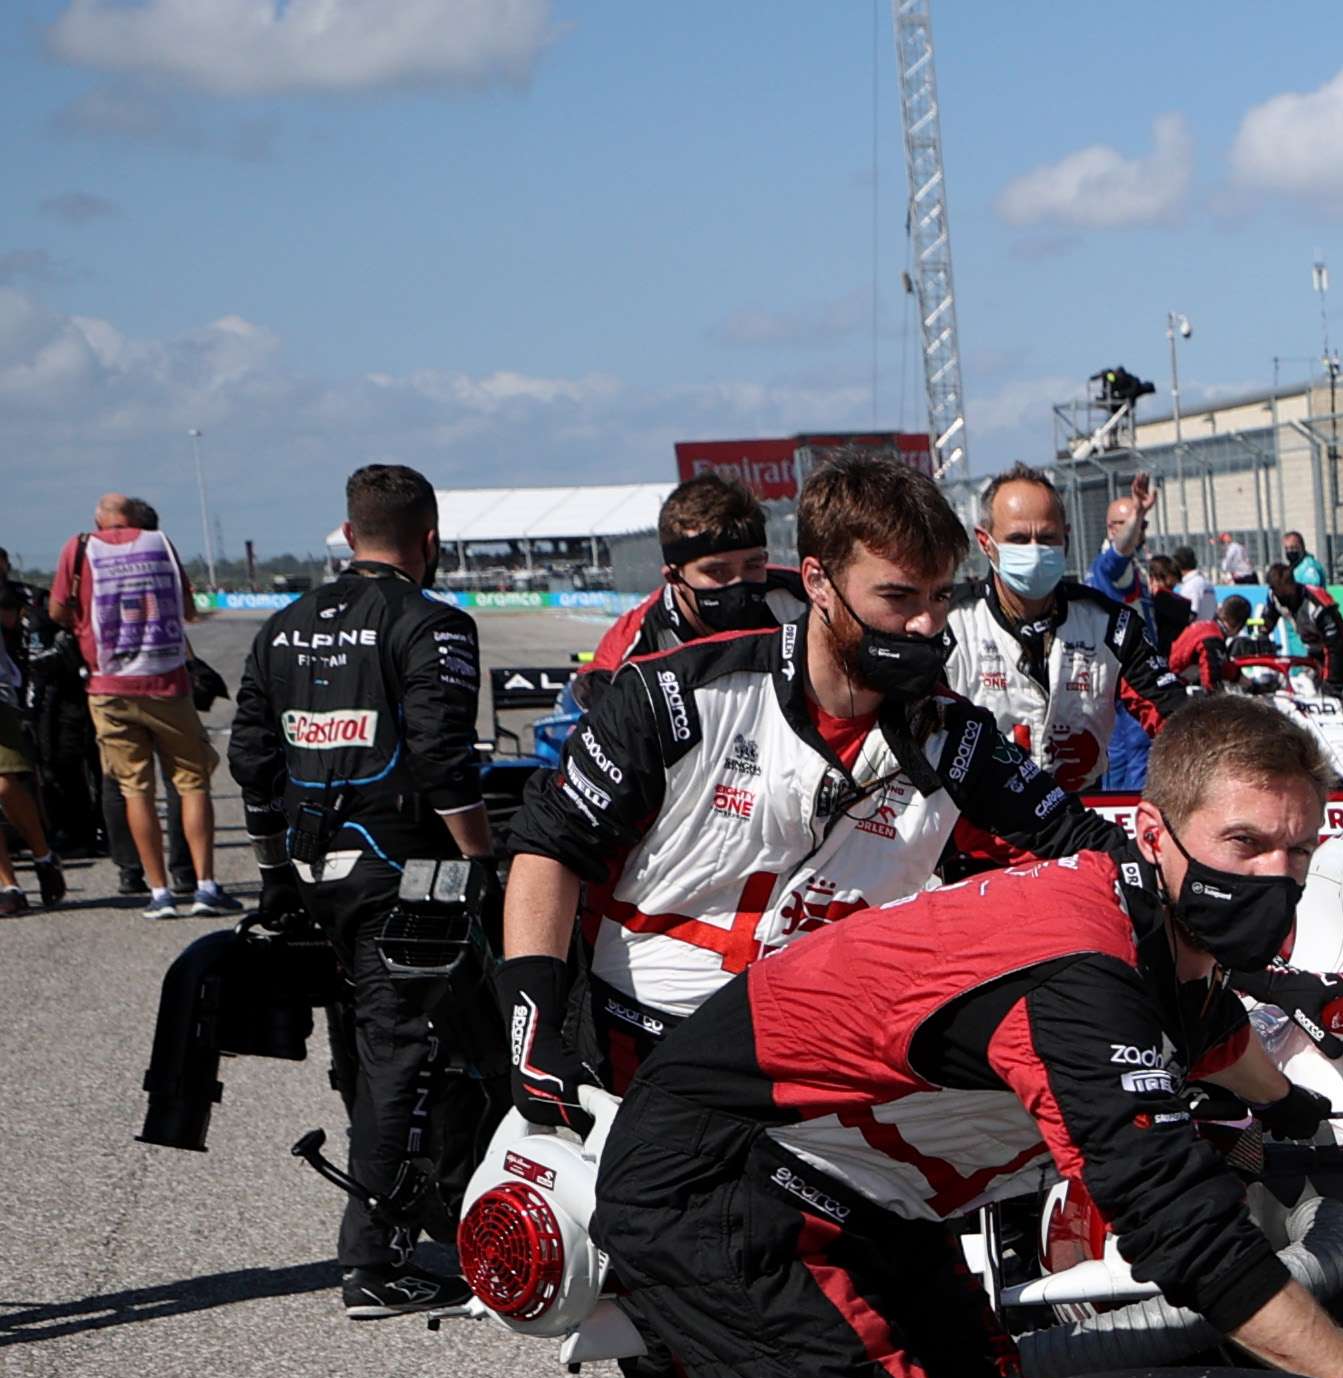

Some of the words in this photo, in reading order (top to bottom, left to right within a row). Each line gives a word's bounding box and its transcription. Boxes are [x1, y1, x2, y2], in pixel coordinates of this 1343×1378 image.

[272, 629, 377, 649] ALPNE
[295, 715, 368, 743] Castrol
[657, 670, 691, 742] sparco
[581, 727, 623, 784] zadara
[950, 720, 982, 783] sparco
[713, 795, 753, 817] ONE
[511, 1005, 529, 1066] sparco
[605, 998, 664, 1036] sparco
[771, 1166, 853, 1222] sparco
